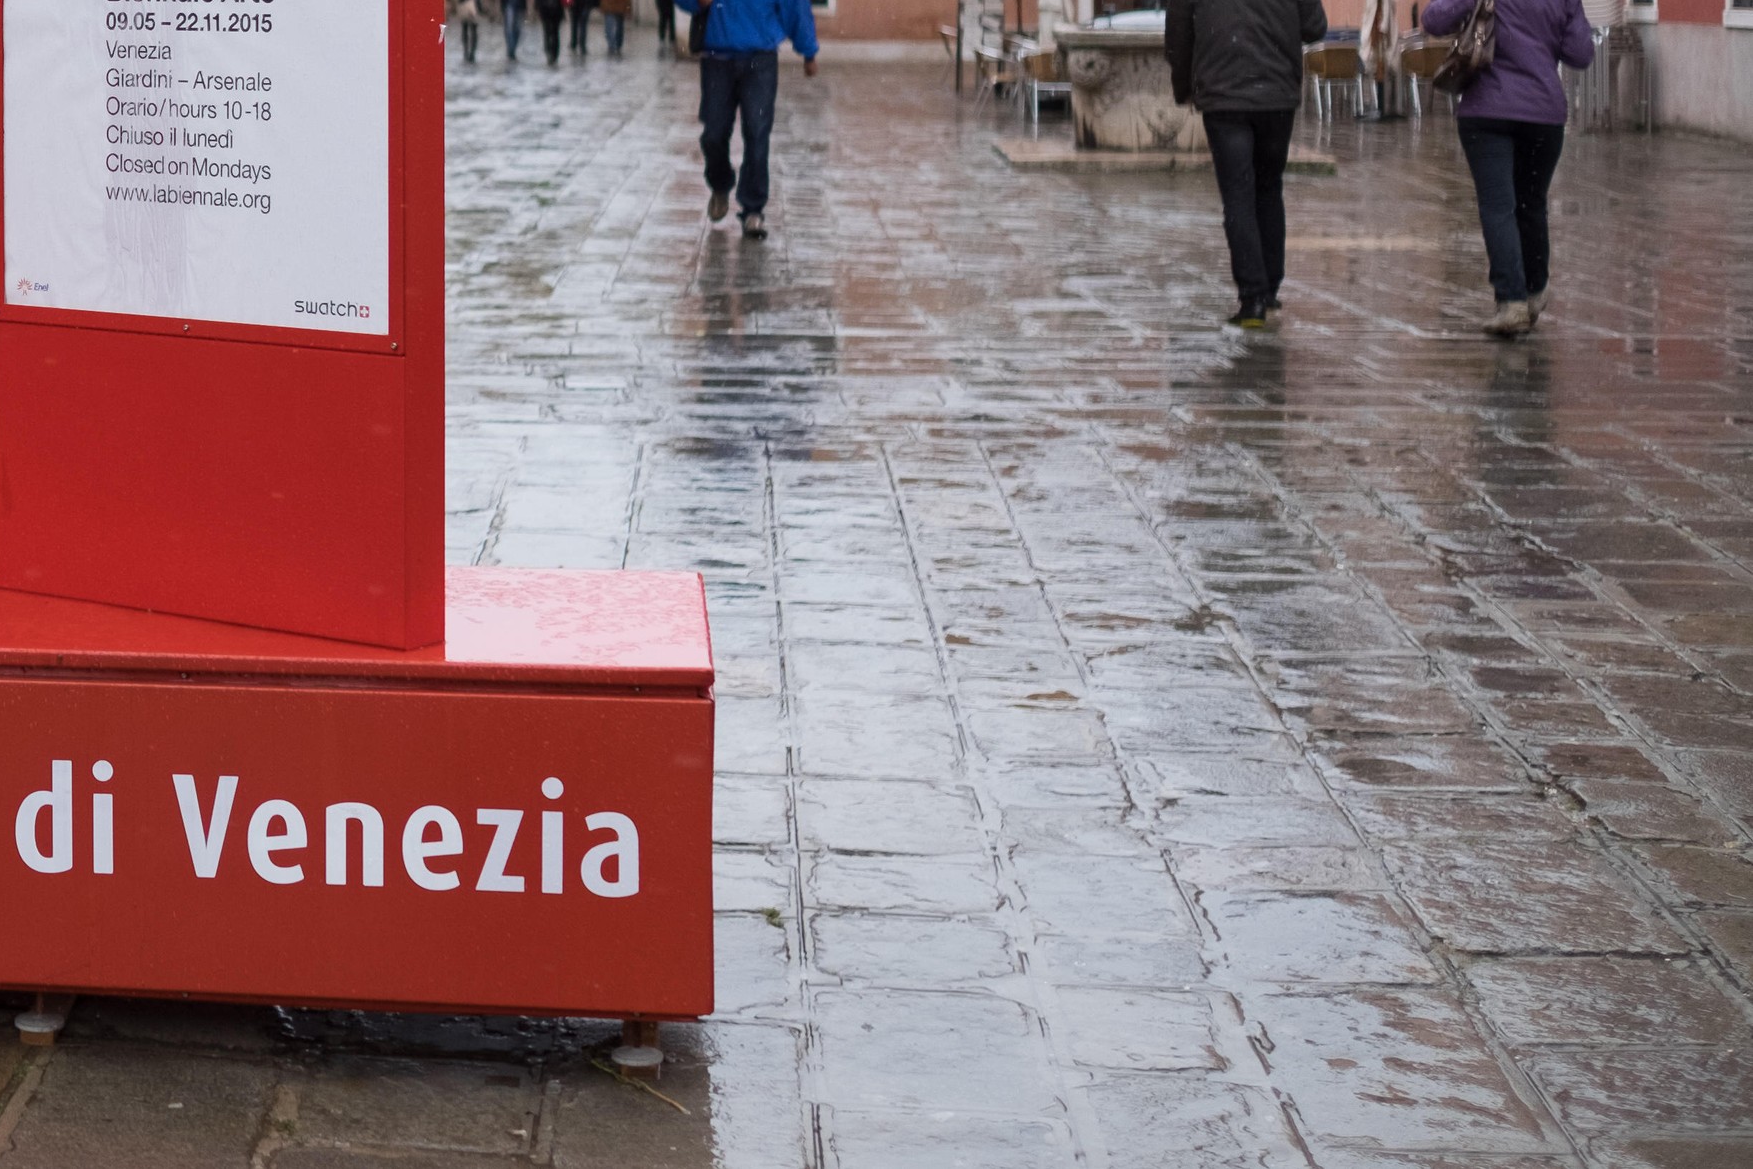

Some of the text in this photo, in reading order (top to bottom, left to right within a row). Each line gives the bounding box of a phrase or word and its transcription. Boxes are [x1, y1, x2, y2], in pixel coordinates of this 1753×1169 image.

[106, 11, 273, 33] 09.05 22.11.2015
[106, 40, 172, 60] Venezia
[106, 68, 272, 92] Giardini Arsenale
[106, 124, 233, 149] Chiuso il lunedì
[106, 152, 271, 184] Closed on Mondays
[106, 184, 271, 214] www.labiennale.org
[295, 300, 357, 317] swatch
[14, 759, 114, 874] di
[172, 773, 639, 899] Venezia
